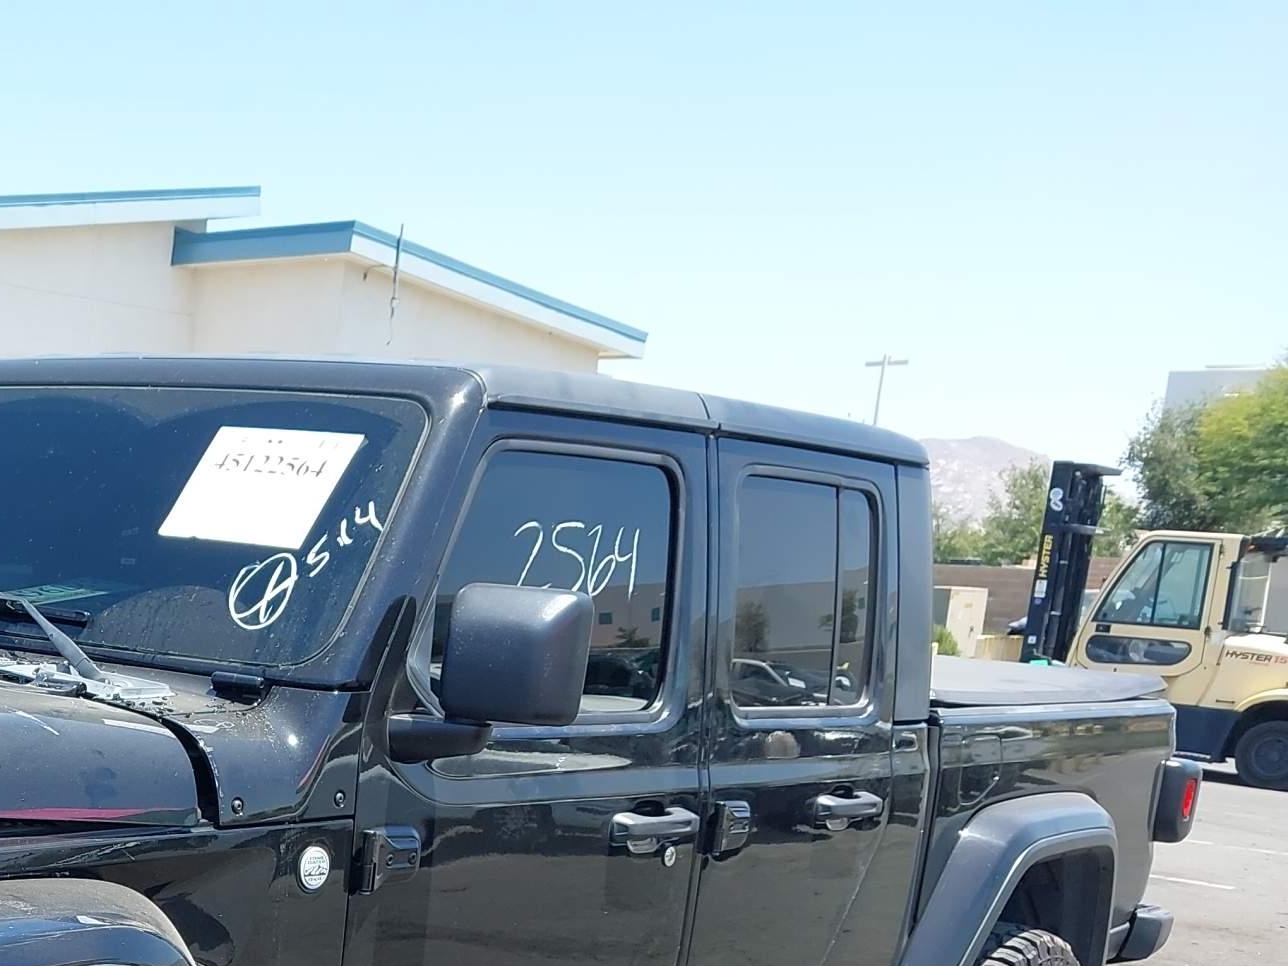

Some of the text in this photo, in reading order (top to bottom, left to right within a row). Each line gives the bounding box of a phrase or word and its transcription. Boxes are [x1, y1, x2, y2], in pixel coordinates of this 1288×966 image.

[513, 520, 640, 601] 2564
[1038, 534, 1054, 578] HYSTER
[1225, 649, 1273, 664] HYSTER
